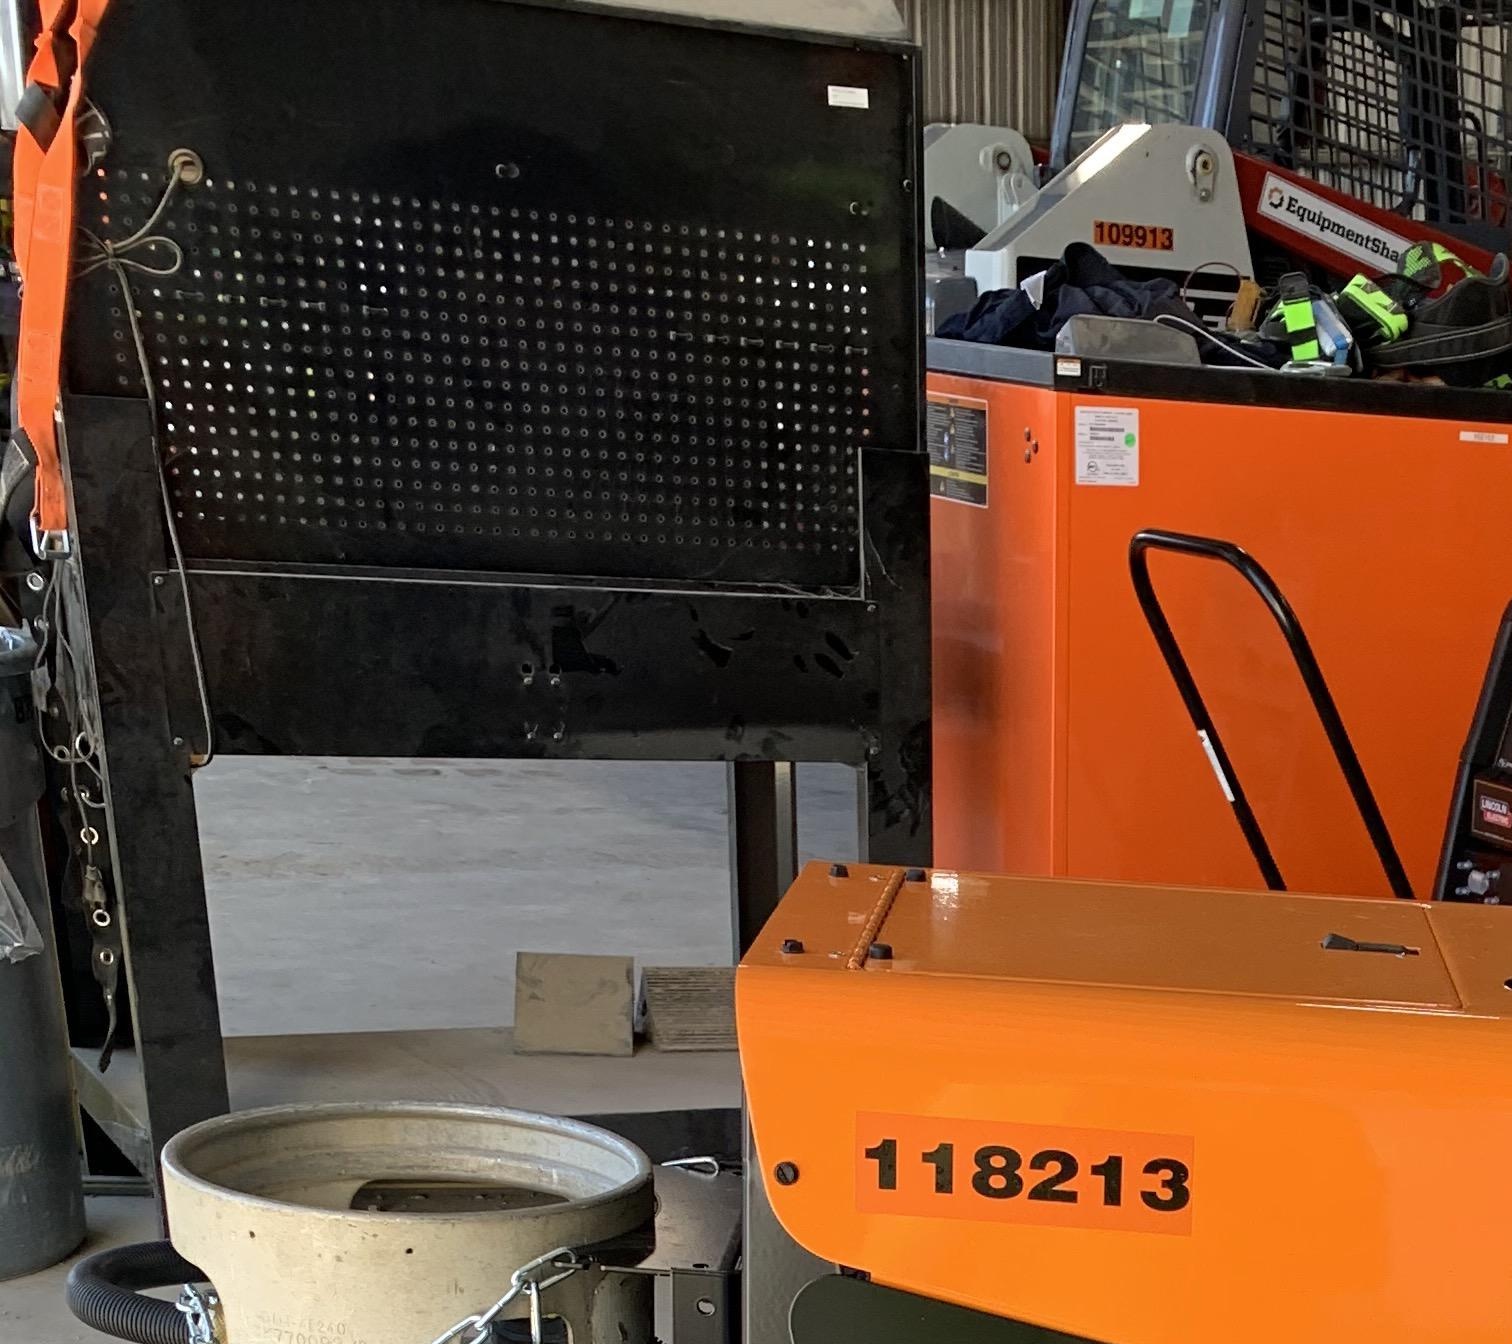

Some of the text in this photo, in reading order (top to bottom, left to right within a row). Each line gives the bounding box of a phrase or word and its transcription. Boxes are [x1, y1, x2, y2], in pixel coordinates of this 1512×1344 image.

[1095, 220, 1174, 251] 109913
[1286, 196, 1400, 262] EquipmentSha
[865, 1139, 1191, 1212] 118213
